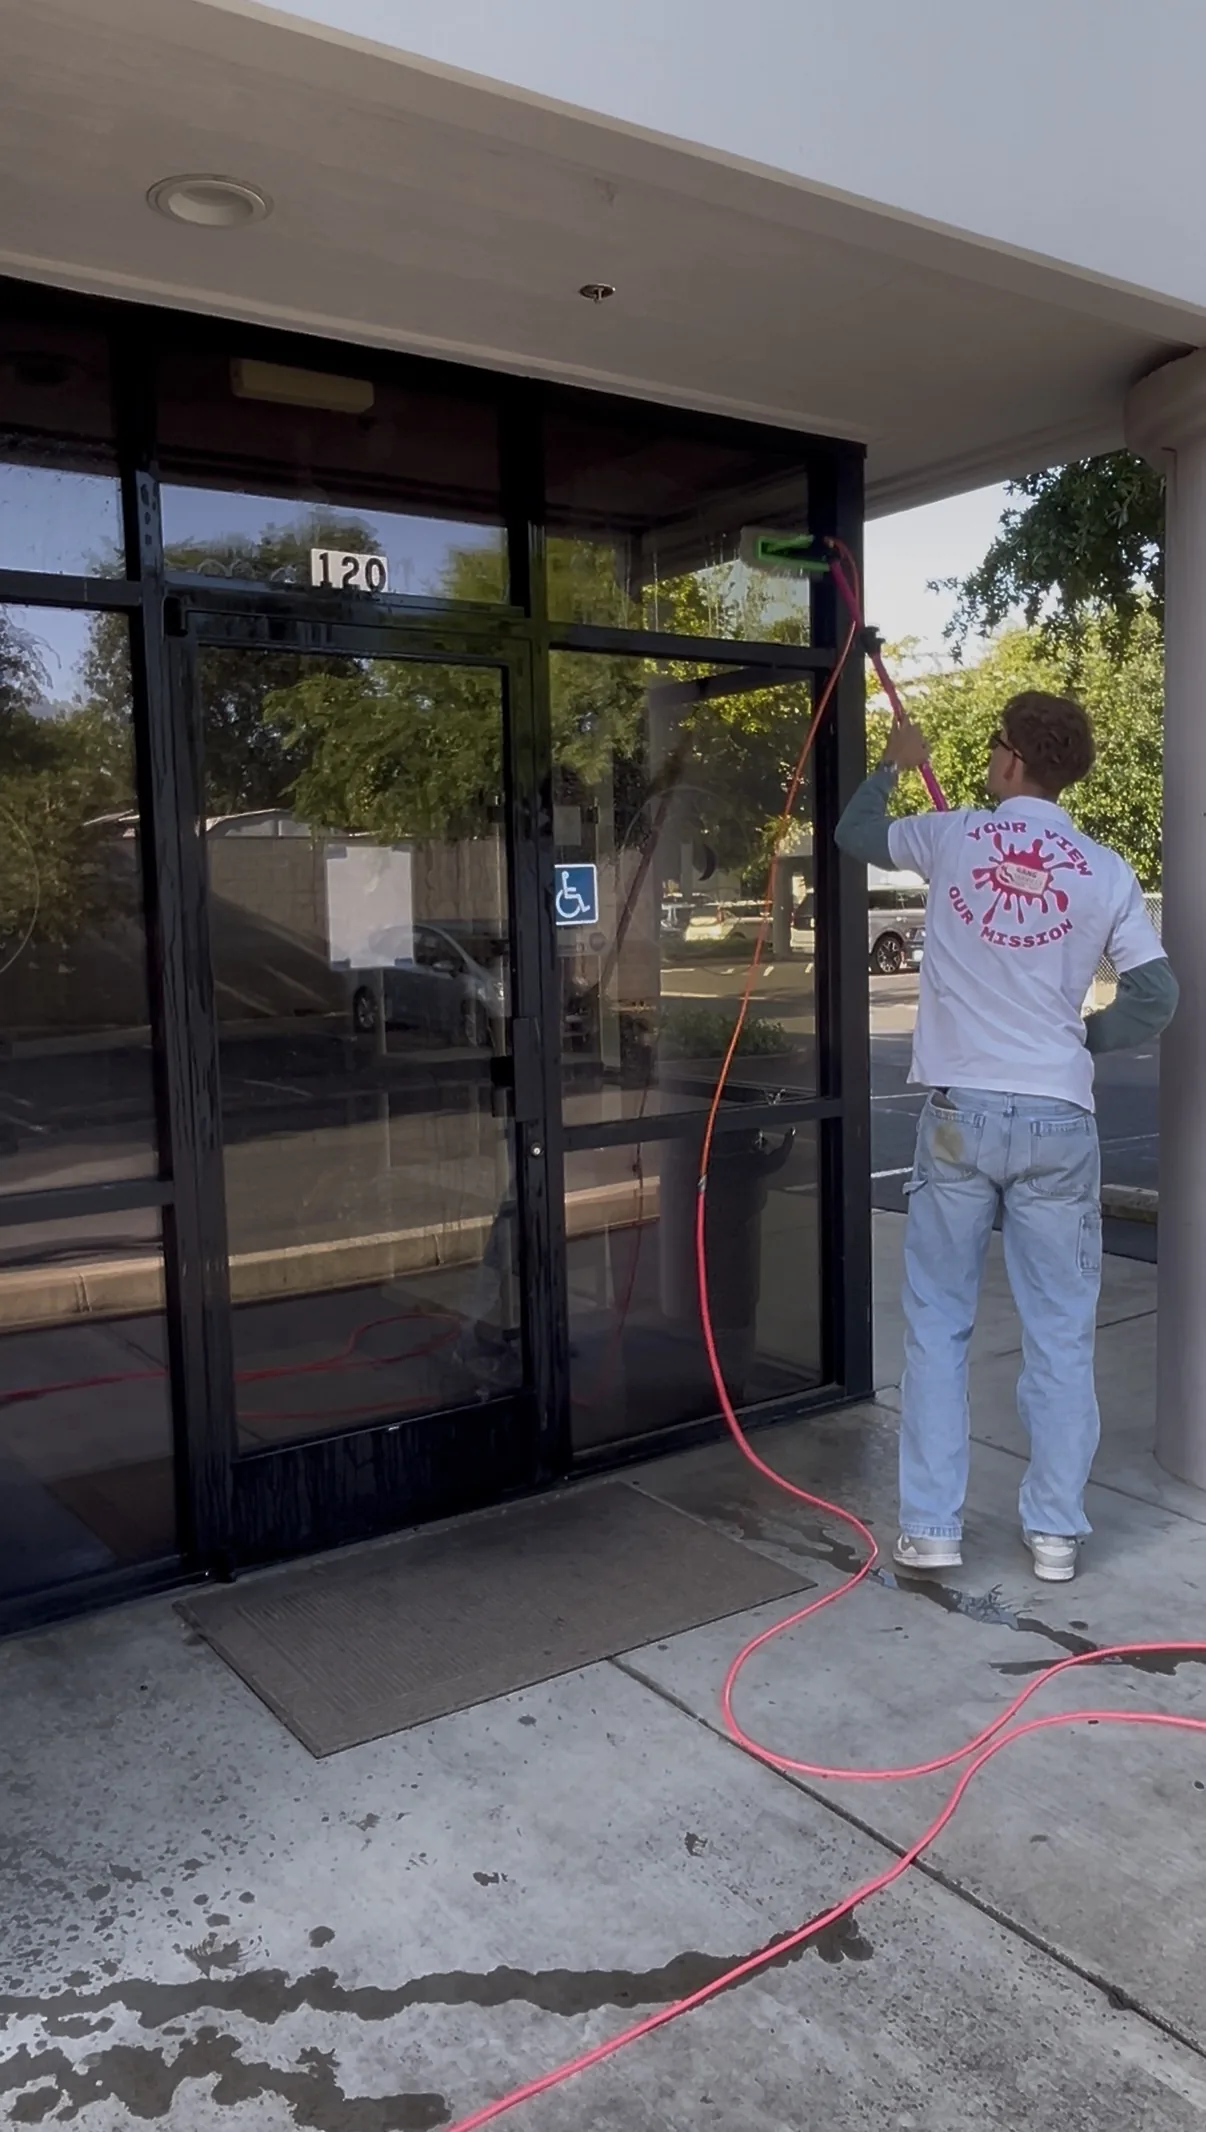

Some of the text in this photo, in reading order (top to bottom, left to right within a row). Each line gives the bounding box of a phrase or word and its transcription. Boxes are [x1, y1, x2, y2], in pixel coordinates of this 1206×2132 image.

[319, 552, 386, 592] 120
[966, 821, 1093, 876] YOUR VIEW
[949, 886, 1073, 948] OUR MISSION
